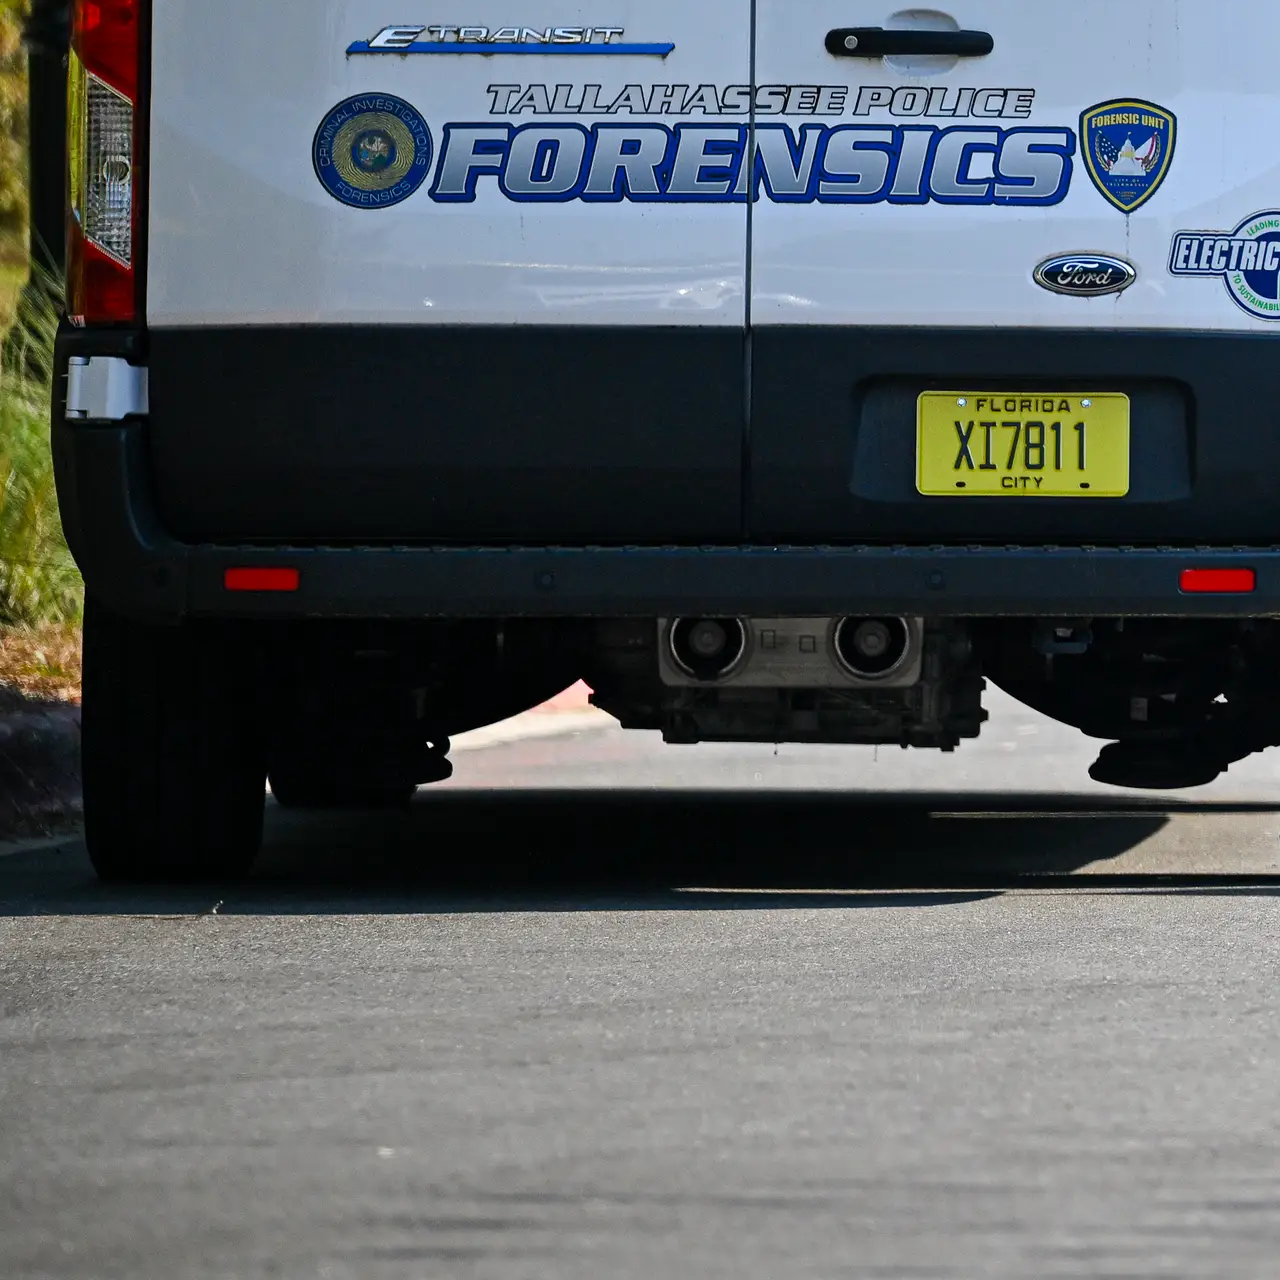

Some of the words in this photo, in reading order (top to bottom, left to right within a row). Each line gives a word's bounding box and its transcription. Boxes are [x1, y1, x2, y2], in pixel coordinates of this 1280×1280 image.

[486, 84, 848, 116] TALLAHASSEE
[852, 85, 1036, 119] POLICE
[1091, 113, 1140, 129] FORENSIC
[1141, 114, 1165, 130] UNIT
[320, 109, 353, 167] CRIMINAL
[352, 99, 428, 166] INVESTIGATIONS
[428, 122, 1077, 207] FORENSICS
[335, 180, 411, 203] FORENSICS
[1246, 219, 1280, 237] LEADING
[1057, 262, 1112, 284] Ford
[1233, 273, 1242, 284] TO
[976, 398, 1071, 412] FLORIDA
[954, 420, 1085, 470] XI7811
[1001, 476, 1044, 488] CITY
